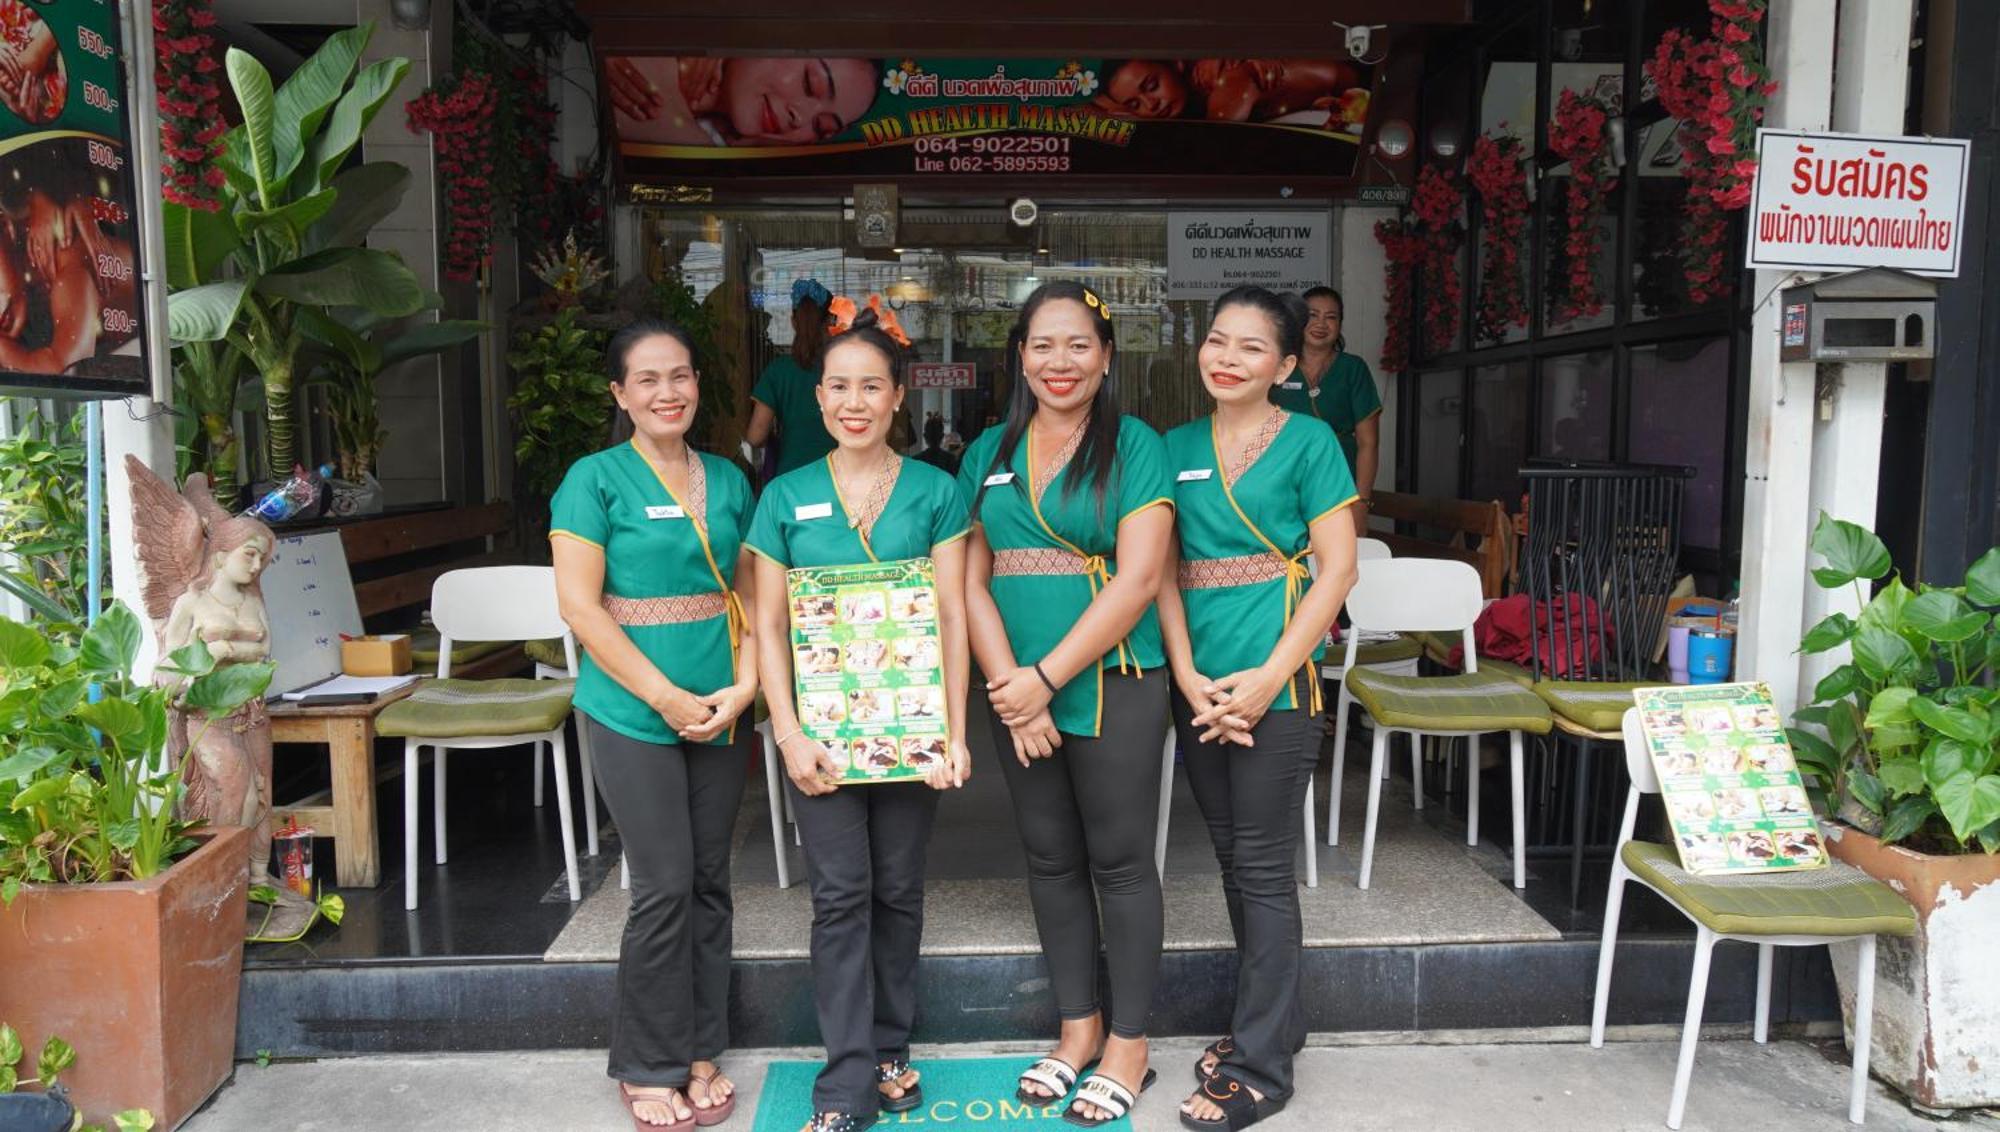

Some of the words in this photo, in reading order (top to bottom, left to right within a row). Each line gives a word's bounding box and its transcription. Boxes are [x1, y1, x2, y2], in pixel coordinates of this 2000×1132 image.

[905, 74, 939, 97] ดีดี
[943, 65, 1078, 101] นวดเพื่อสุขภาพ
[861, 116, 901, 146] DD
[908, 103, 1010, 134] HEALTH
[1017, 103, 1136, 146] MASSAGE
[914, 136, 1070, 153] 064-9022501
[915, 156, 944, 172] Line
[950, 157, 1070, 172] 062-5895593
[1791, 144, 1929, 202] รับสมัคร
[1759, 204, 1952, 251] พนักงานนวดแผนไทย
[1192, 247, 1208, 259] DD
[1211, 247, 1251, 259] HEALTH
[1255, 247, 1305, 259] MASSAGE
[915, 377, 969, 386] PUSH
